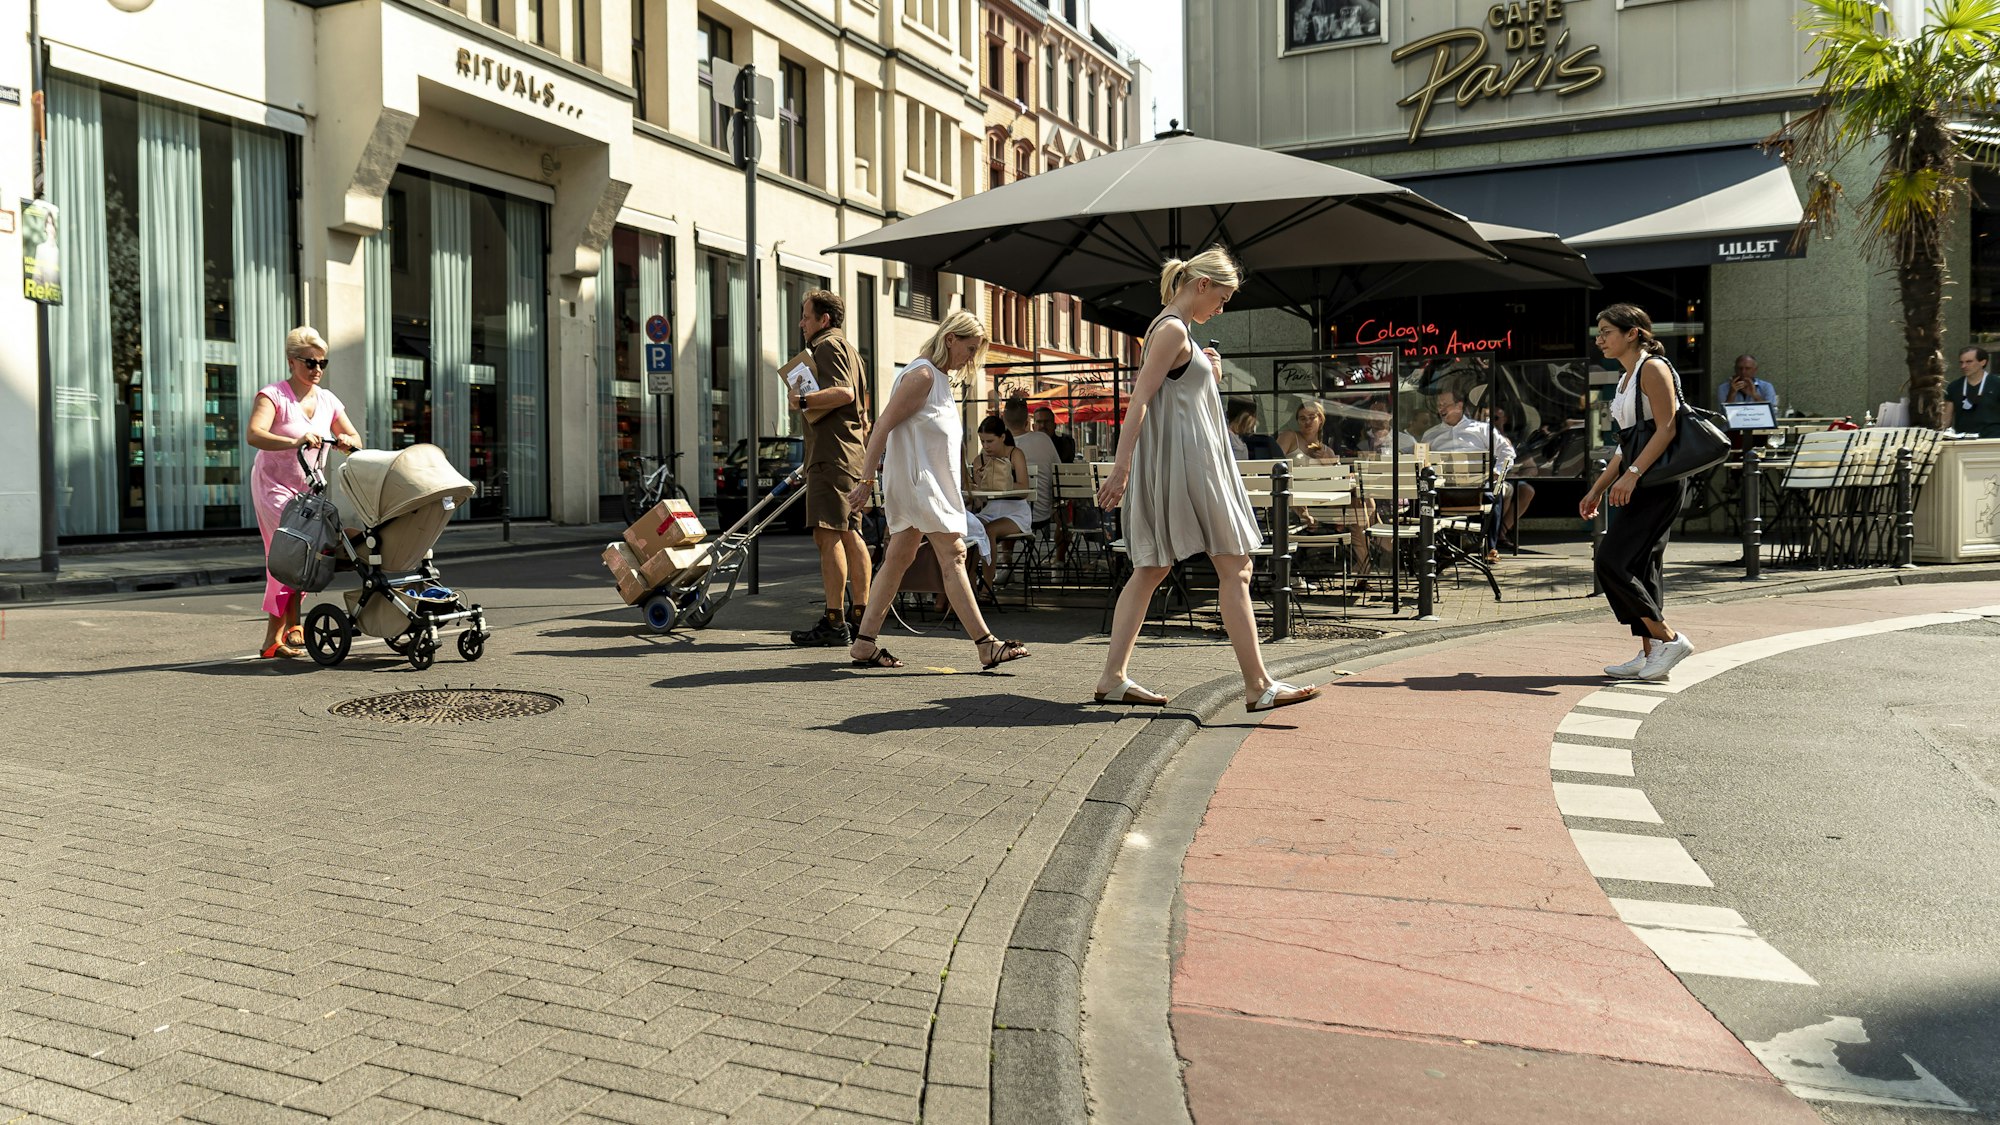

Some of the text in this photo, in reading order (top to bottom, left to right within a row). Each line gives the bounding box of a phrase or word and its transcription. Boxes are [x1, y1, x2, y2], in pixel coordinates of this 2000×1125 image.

[1505, 26, 1546, 50] DE
[1391, 27, 1605, 145] Paris
[1718, 239, 1780, 256] LILLET
[652, 347, 666, 369] P
[1284, 367, 1314, 386] Paris
